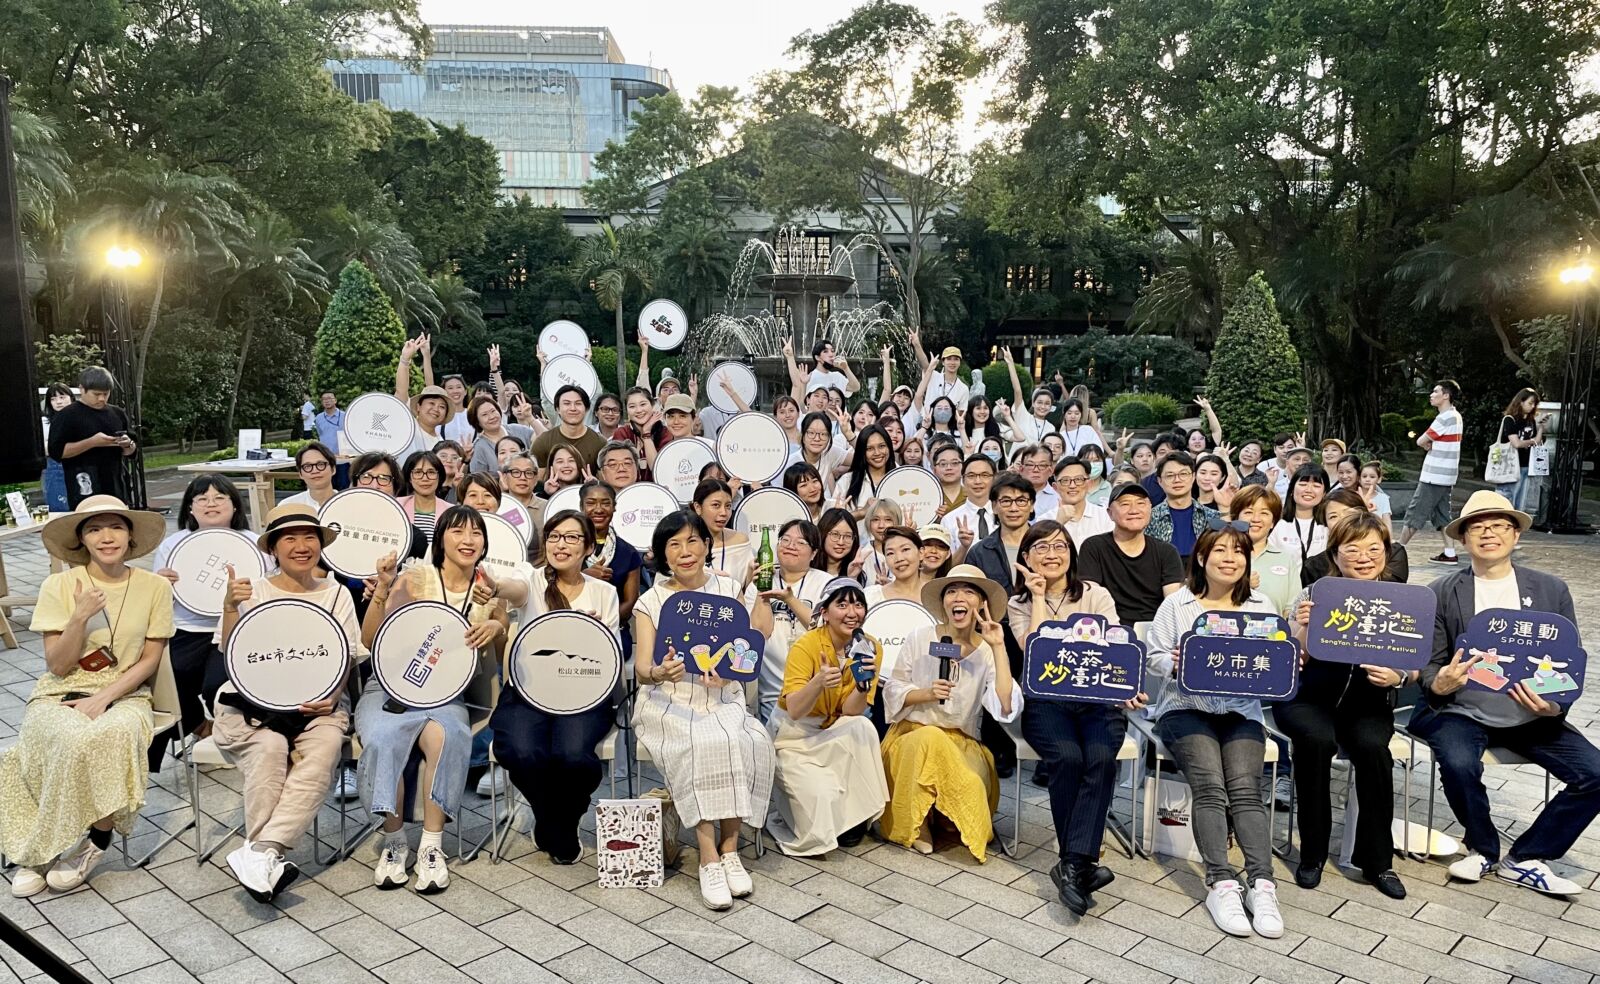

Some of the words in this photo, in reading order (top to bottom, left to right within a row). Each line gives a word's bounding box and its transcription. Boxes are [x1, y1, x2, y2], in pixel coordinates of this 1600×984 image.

[676, 599, 734, 622] 炒音樂
[1344, 595, 1391, 616] 松菸
[687, 617, 720, 628] MUSIC
[1487, 617, 1559, 641] 炒運動
[416, 625, 442, 660] 捷克中心
[1353, 641, 1385, 650] Summer
[1387, 645, 1417, 654] Festival
[1500, 636, 1542, 647] SPORT
[247, 644, 329, 664] 台北市文化局
[427, 647, 444, 666] 臺北
[1057, 647, 1103, 667] 松菸
[1206, 652, 1271, 672] 炒市集
[558, 667, 601, 675] 松山文創園區
[1214, 670, 1261, 679] MARKET
